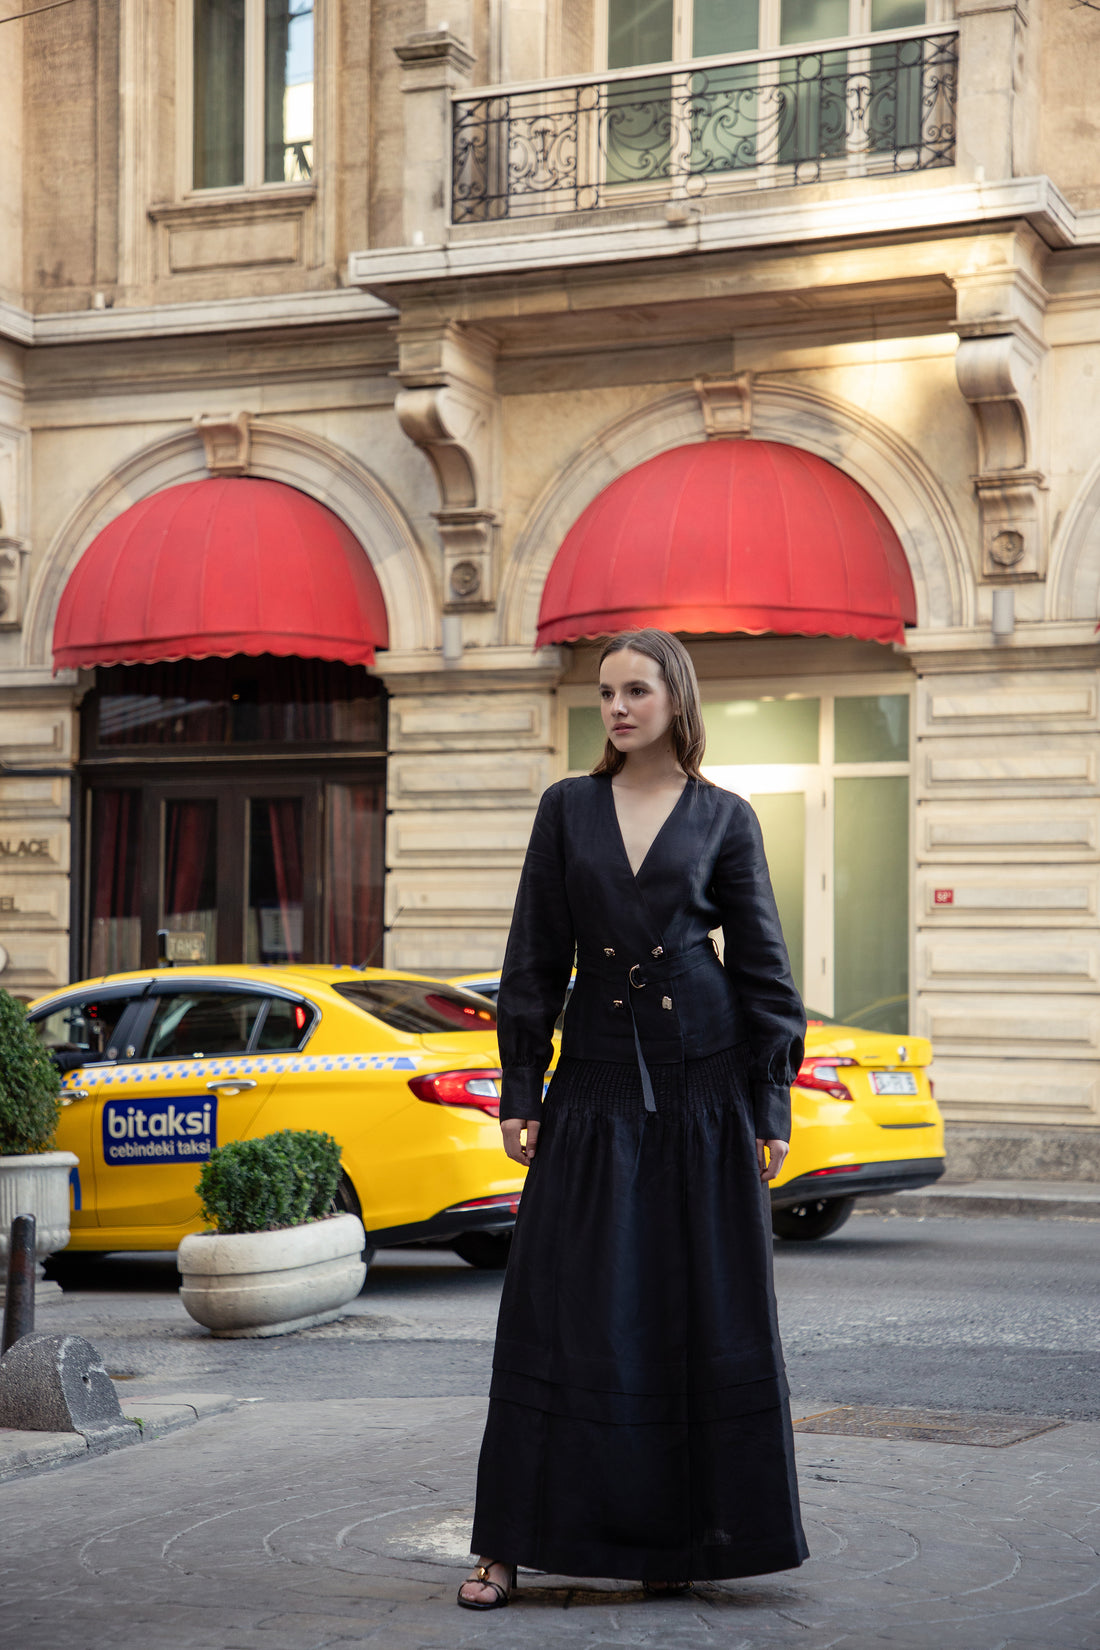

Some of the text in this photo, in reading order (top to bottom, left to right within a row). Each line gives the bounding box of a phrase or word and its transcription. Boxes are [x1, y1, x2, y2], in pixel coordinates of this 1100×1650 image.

[108, 1103, 211, 1139] bitaksi
[109, 1138, 211, 1158] cebindeki taksi
